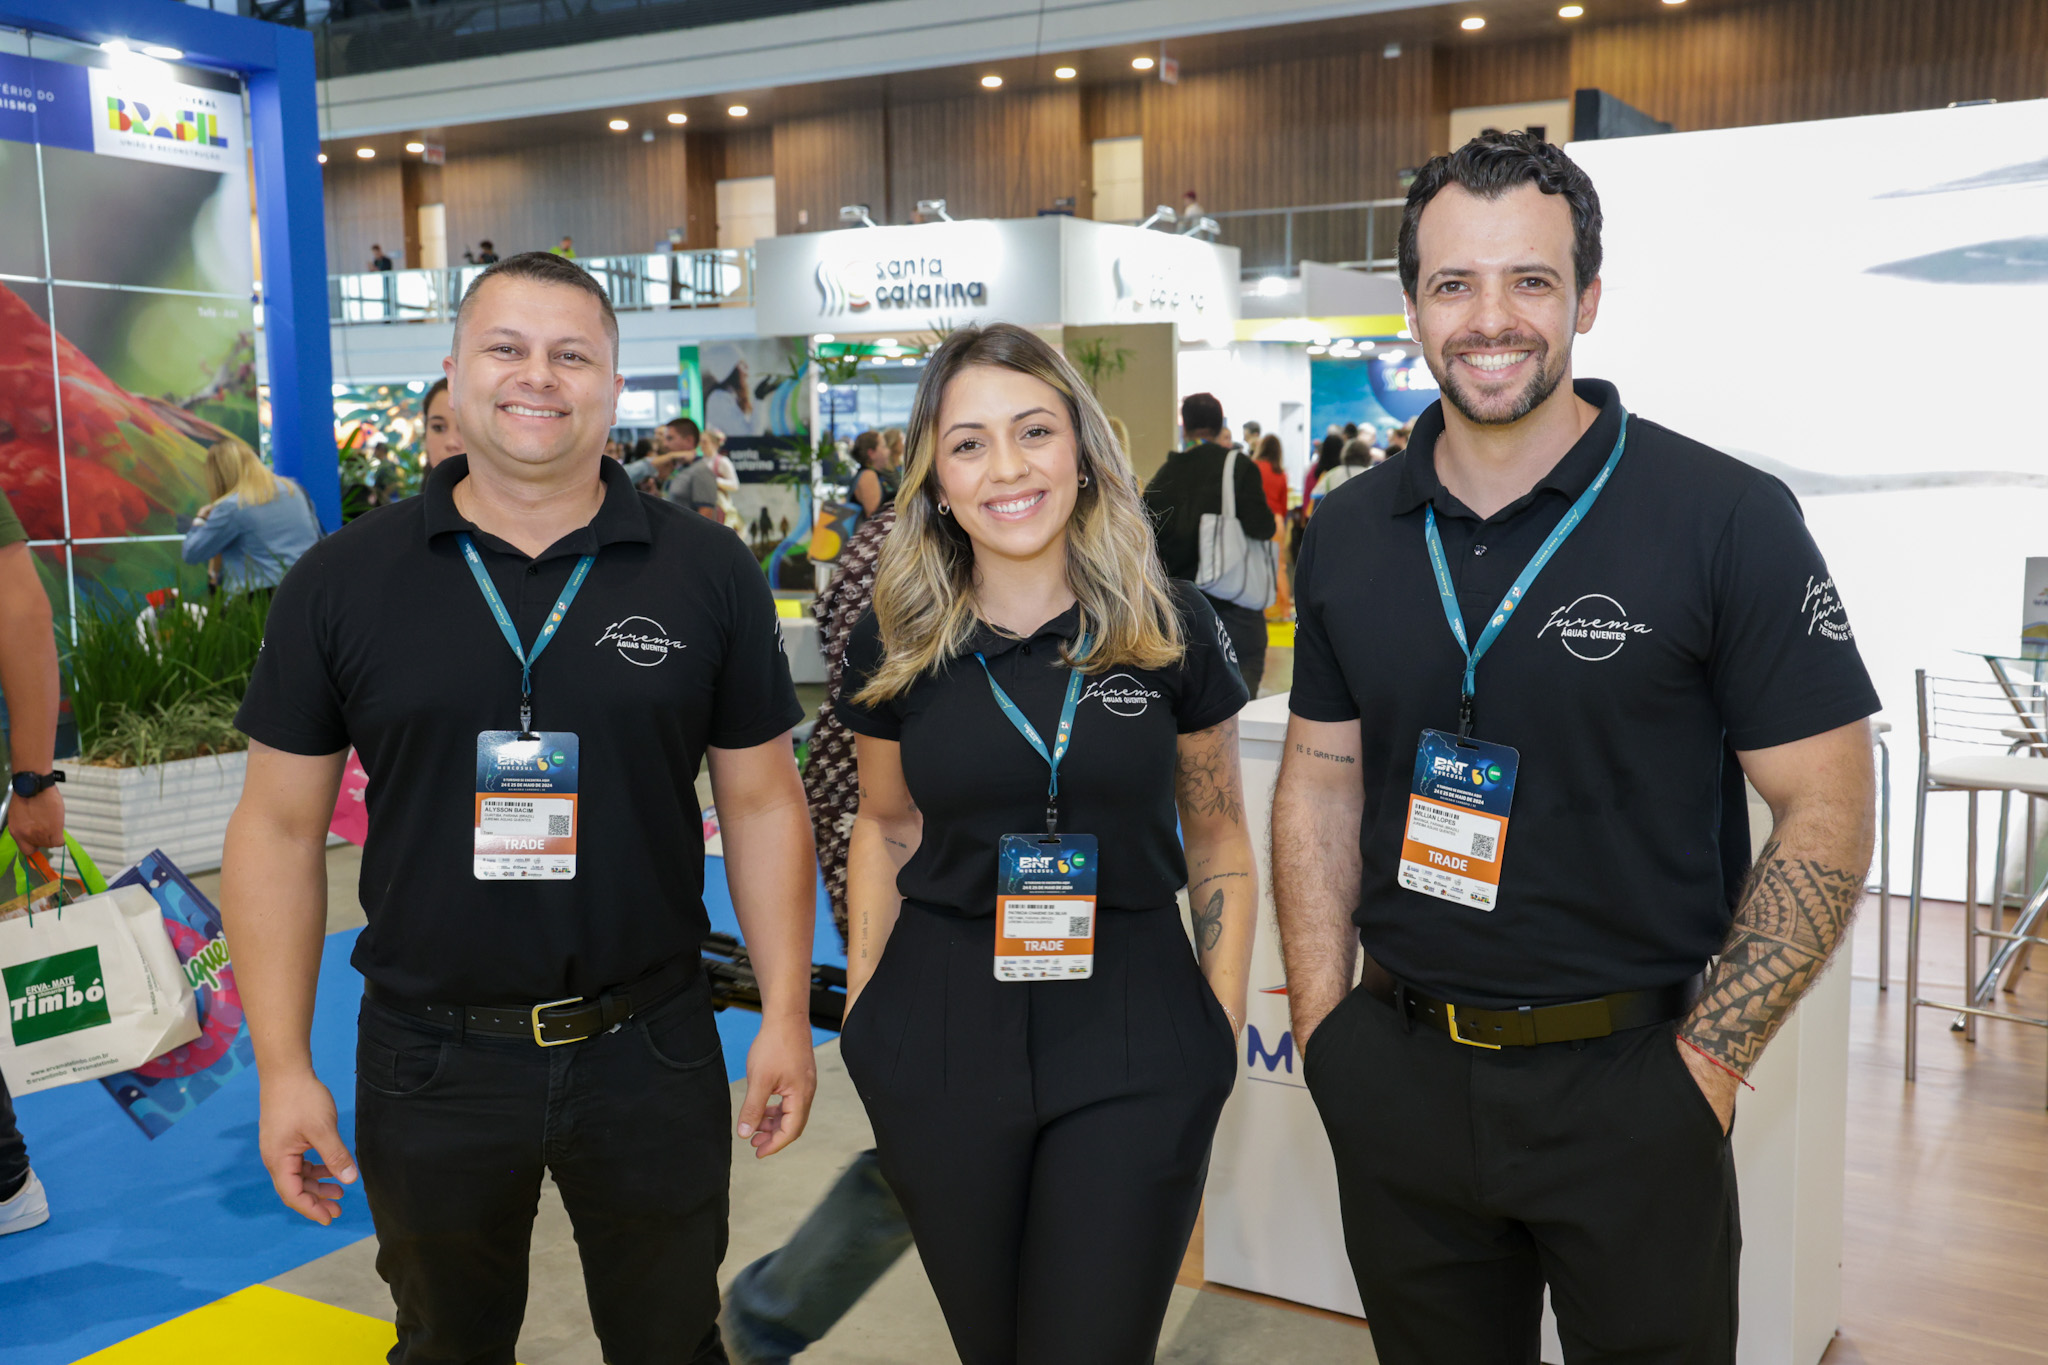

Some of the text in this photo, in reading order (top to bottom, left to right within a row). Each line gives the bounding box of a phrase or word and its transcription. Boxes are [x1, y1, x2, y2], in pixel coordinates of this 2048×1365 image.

[0, 83, 55, 102] ÉRIO DO
[107, 96, 228, 149] BRASIL
[876, 257, 942, 279] santa
[876, 280, 986, 306] catarina
[733, 460, 775, 472] atarina
[1537, 606, 1653, 639] Jurema
[595, 622, 687, 649] Jurema
[1561, 626, 1626, 641] ÁGUAS QUENTES
[1818, 623, 1849, 642] TERMAS
[617, 639, 668, 654] ÁGUAS QUENTES
[1077, 682, 1162, 705] Jurema
[1124, 696, 1148, 704] QUENTES
[1314, 750, 1355, 764] GRATIDÃO
[1434, 756, 1469, 775] BNT
[1433, 769, 1467, 782] MERCOSUL
[1455, 793, 1466, 801] MAIO
[1414, 810, 1456, 826] WILLIAN LOPES
[504, 839, 545, 850] TRADE
[1019, 857, 1054, 869] BNT
[1428, 850, 1468, 872] TRADE
[1023, 940, 1065, 951] TRADE
[52, 975, 76, 989] MATE
[10, 977, 105, 1022] Timbó
